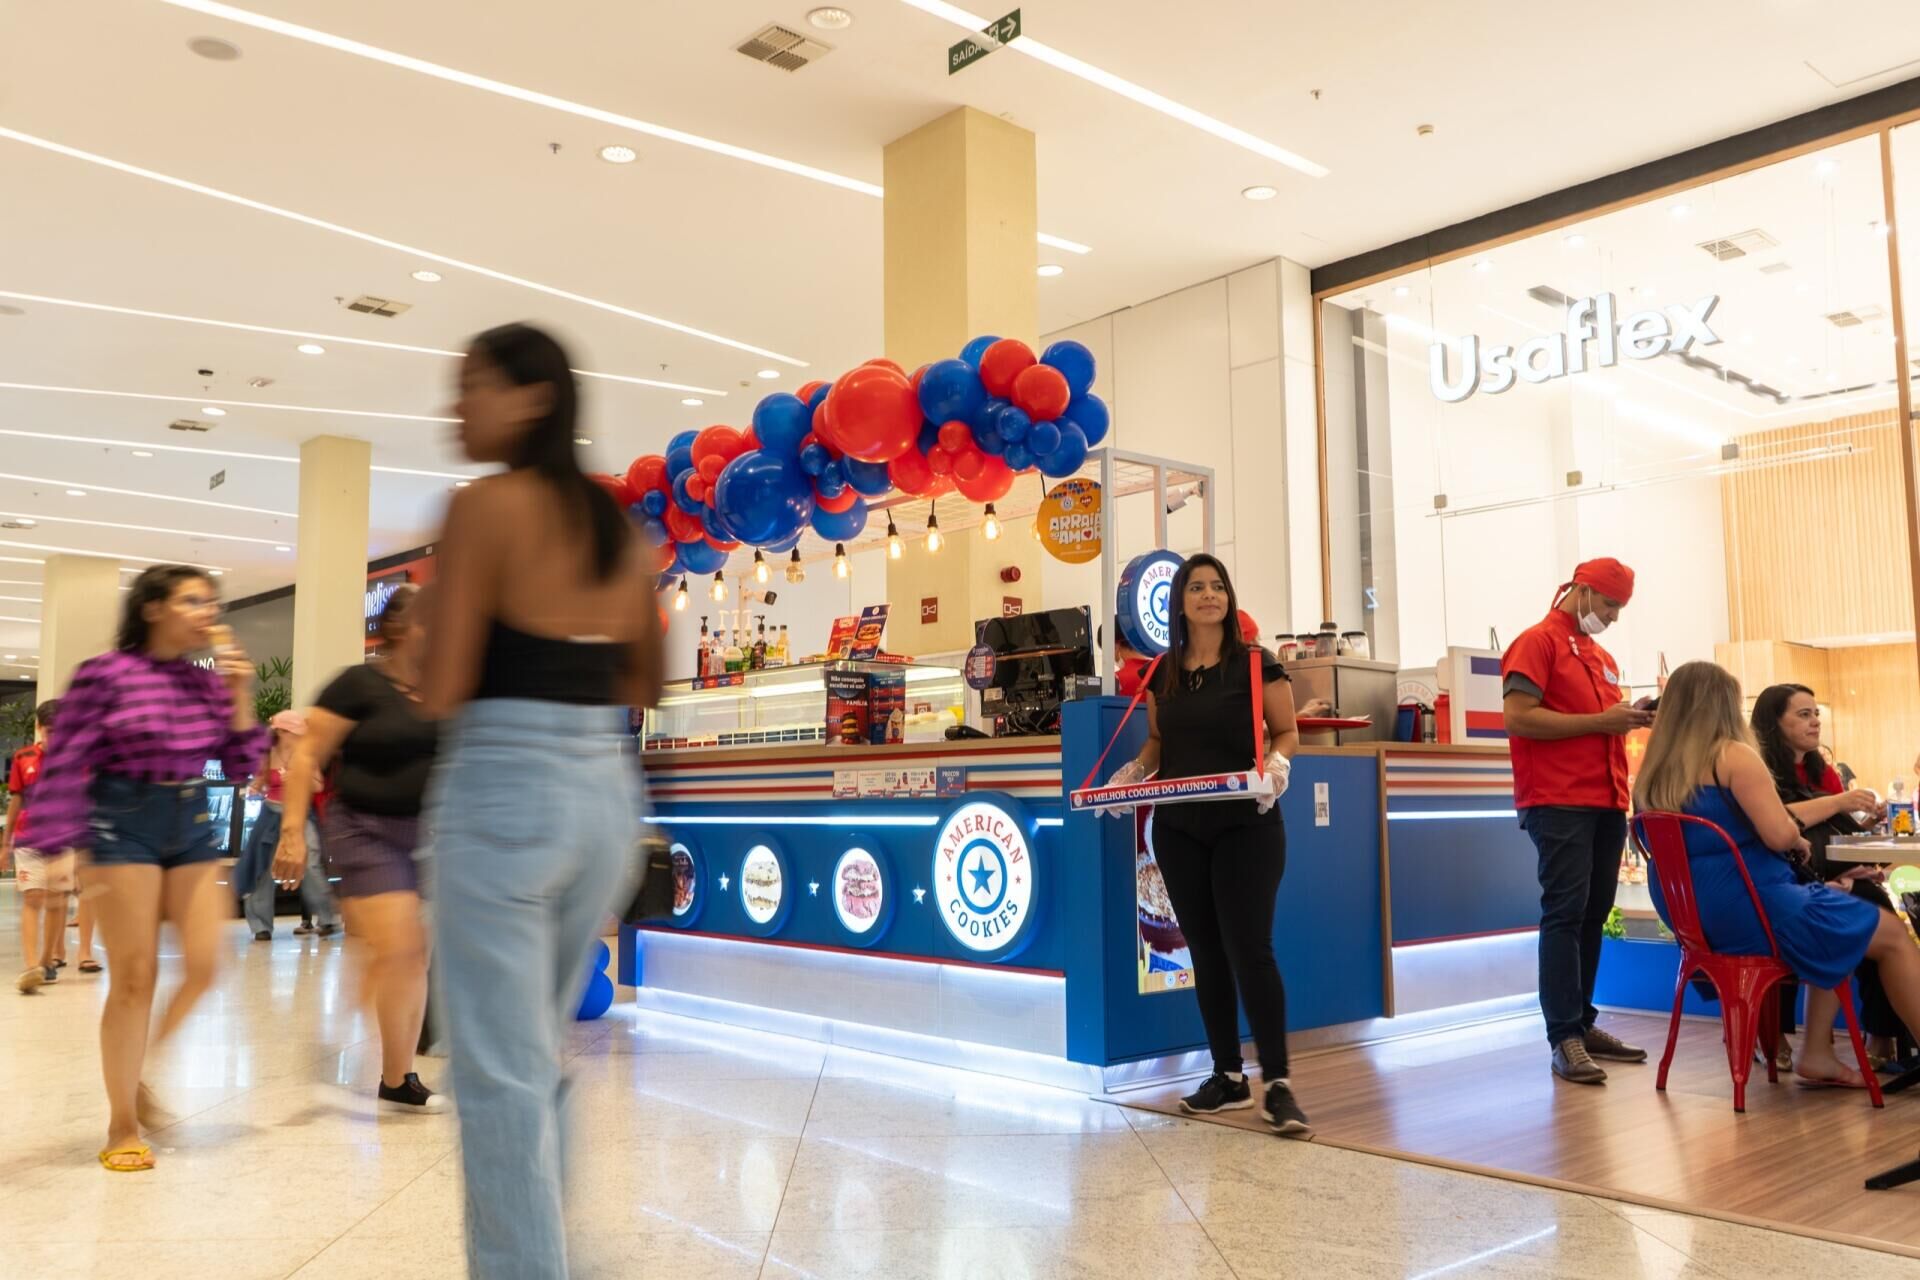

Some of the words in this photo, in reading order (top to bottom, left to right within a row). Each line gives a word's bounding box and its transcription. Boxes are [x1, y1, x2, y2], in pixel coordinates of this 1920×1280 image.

[1430, 292, 1723, 404] Usaflex
[1142, 566, 1177, 589] AMER
[1142, 611, 1169, 641] COOK
[1087, 794, 1093, 804] O
[1093, 789, 1127, 803] MELHOR
[1127, 785, 1160, 799] COOKIE
[1162, 783, 1175, 795] DO
[1177, 780, 1218, 792] MUNDO!
[943, 814, 1024, 865] AMERICAN
[950, 898, 1018, 938] COOKIES
